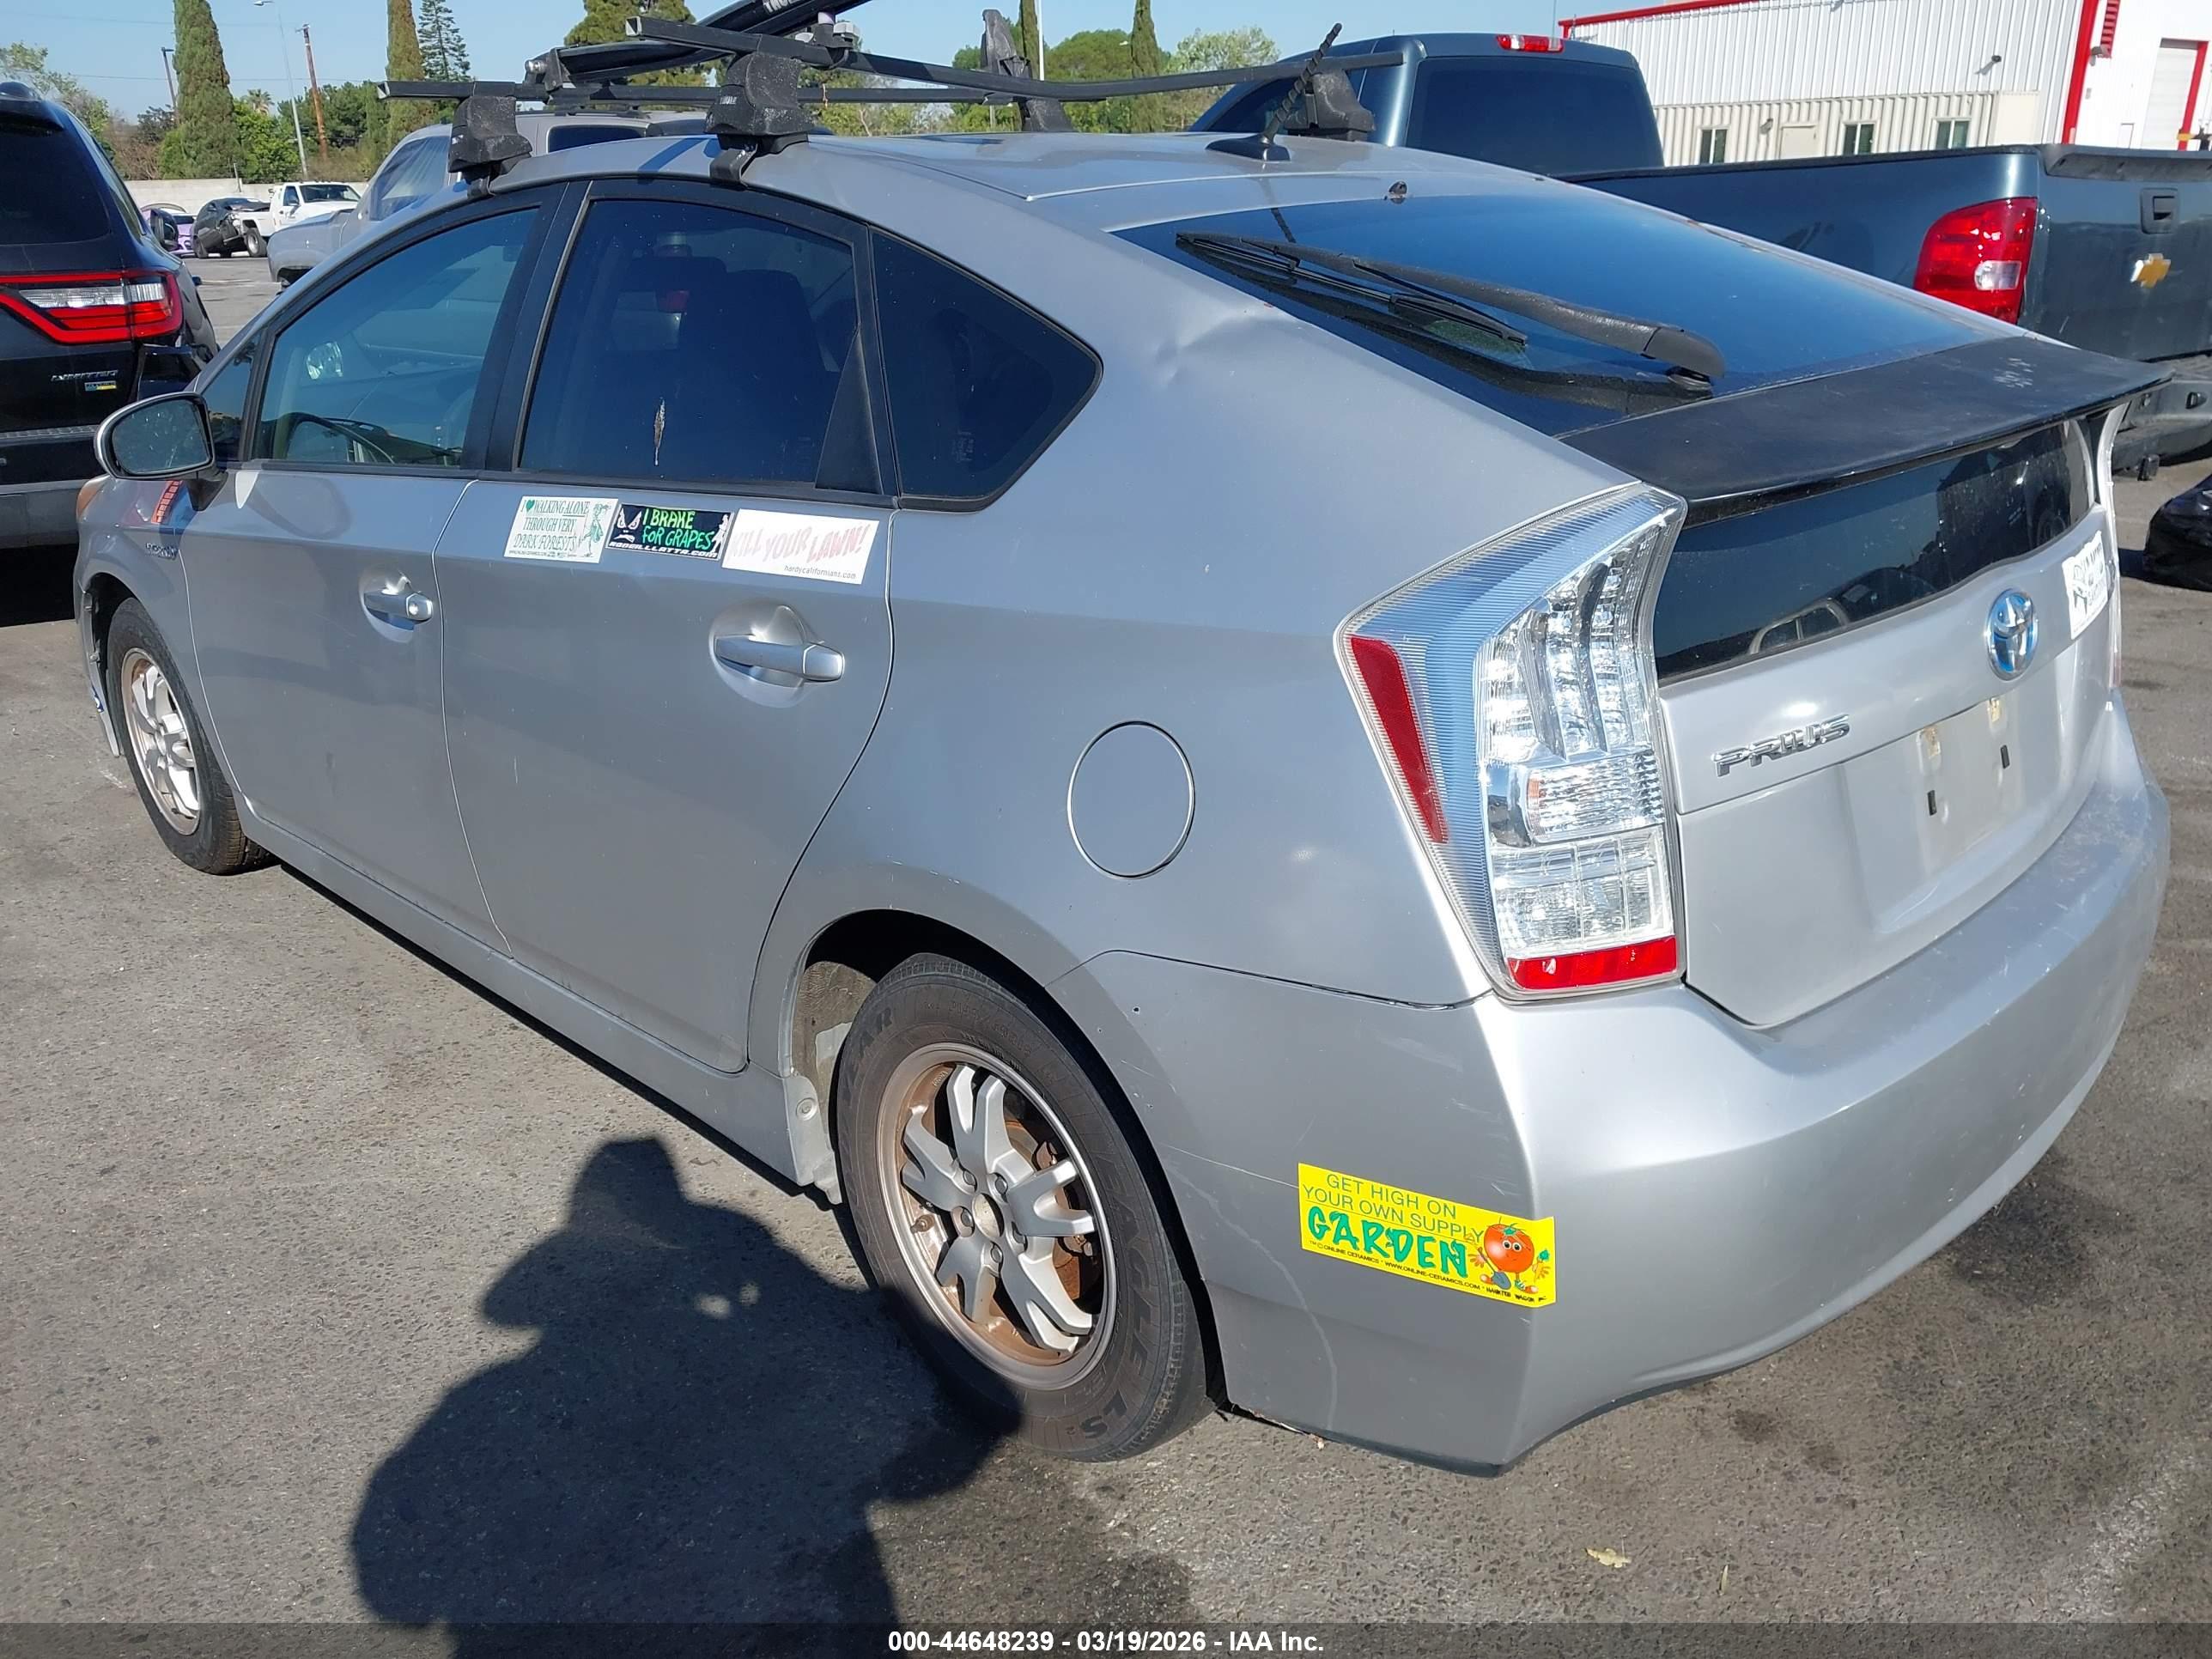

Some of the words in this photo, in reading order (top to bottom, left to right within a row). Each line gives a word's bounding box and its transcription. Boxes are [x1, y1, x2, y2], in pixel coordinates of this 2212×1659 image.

[534, 500, 565, 514] WALKING
[562, 501, 591, 514] ALONE
[642, 508, 650, 526] I
[650, 507, 696, 530] BRAKE
[523, 517, 559, 532] THROUGH
[557, 519, 577, 532] VERY
[665, 528, 714, 550] GRAPES
[513, 534, 539, 549] DARK
[538, 535, 577, 551] FORESTS
[729, 528, 763, 557] KILL
[763, 526, 812, 562] YOUR
[806, 523, 871, 563] LAWN!
[1711, 714, 1850, 776] PRIUS
[1327, 1174, 1364, 1194] GET
[1370, 1186, 1419, 1210] HIGH
[1427, 1200, 1455, 1219] ON
[1303, 1184, 1353, 1210] YOUR
[1359, 1200, 1403, 1224] OWN
[1410, 1212, 1484, 1243] SUPPLY
[1308, 1206, 1468, 1278] GARDEN
